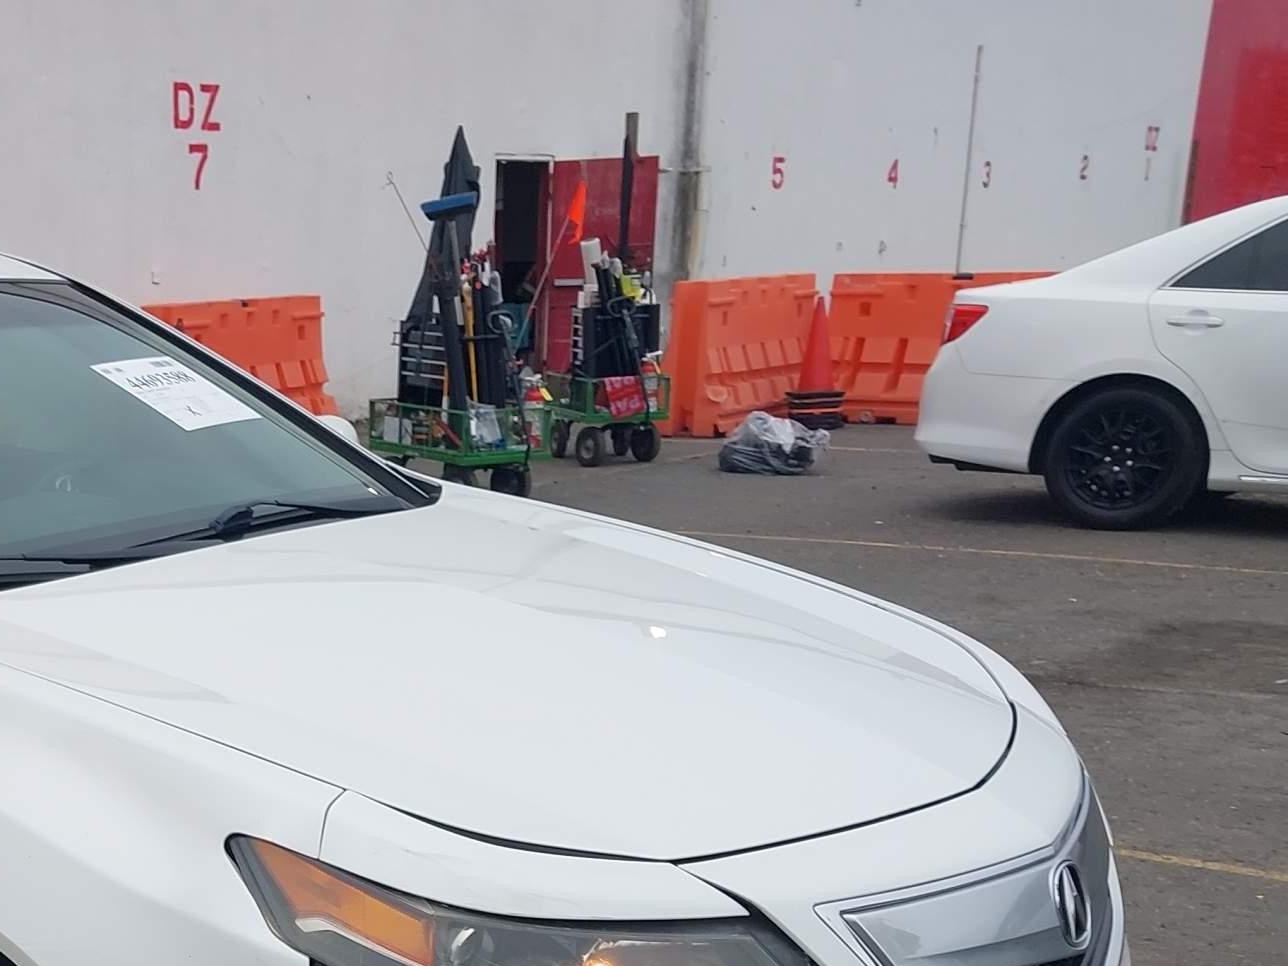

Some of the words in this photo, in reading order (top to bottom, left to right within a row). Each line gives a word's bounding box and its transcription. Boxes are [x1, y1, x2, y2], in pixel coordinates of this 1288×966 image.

[172, 81, 222, 132] DZ
[188, 143, 209, 191] 7
[771, 156, 786, 190] 5
[887, 158, 899, 190] 4
[981, 160, 992, 189] 3
[1079, 154, 1090, 181] 2
[126, 370, 197, 391] 44693588
